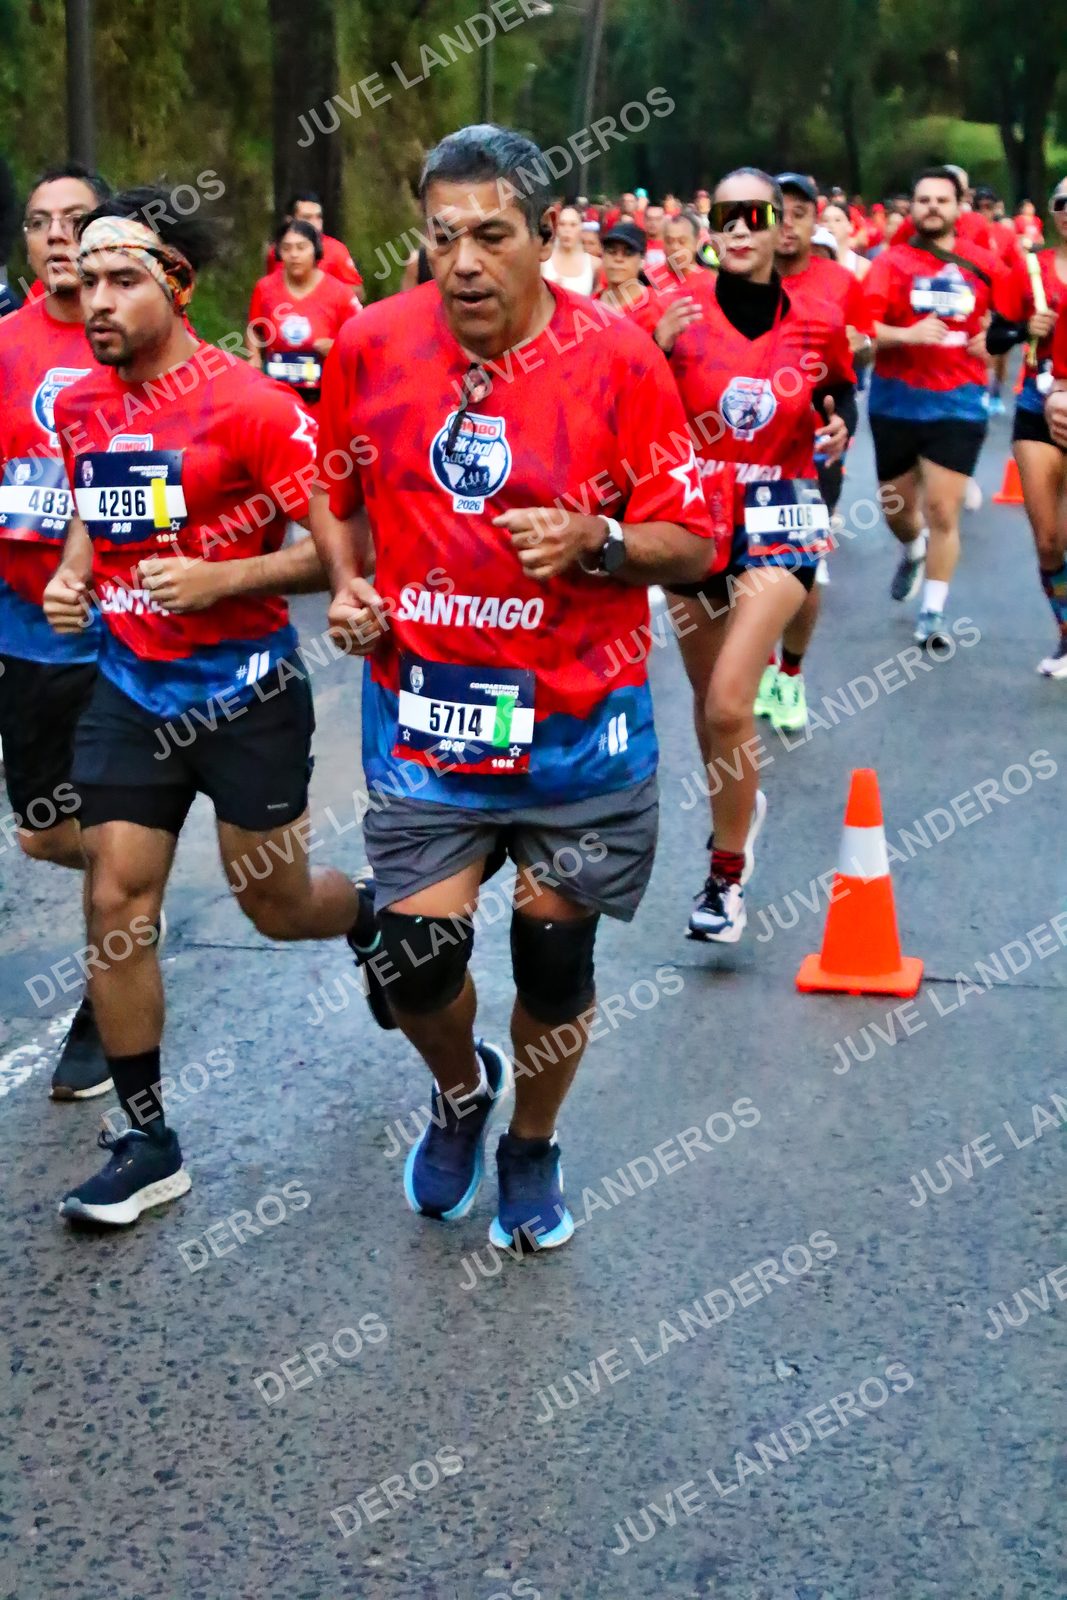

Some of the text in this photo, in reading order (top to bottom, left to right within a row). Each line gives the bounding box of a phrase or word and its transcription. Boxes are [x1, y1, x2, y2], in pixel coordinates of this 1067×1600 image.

[28, 488, 76, 516] 483
[98, 489, 146, 517] 4296
[456, 499, 480, 511] 2026
[156, 533, 178, 543] 10K
[397, 587, 544, 630] SANTIAGO
[429, 702, 482, 737] 5714
[491, 758, 515, 769] 10K
